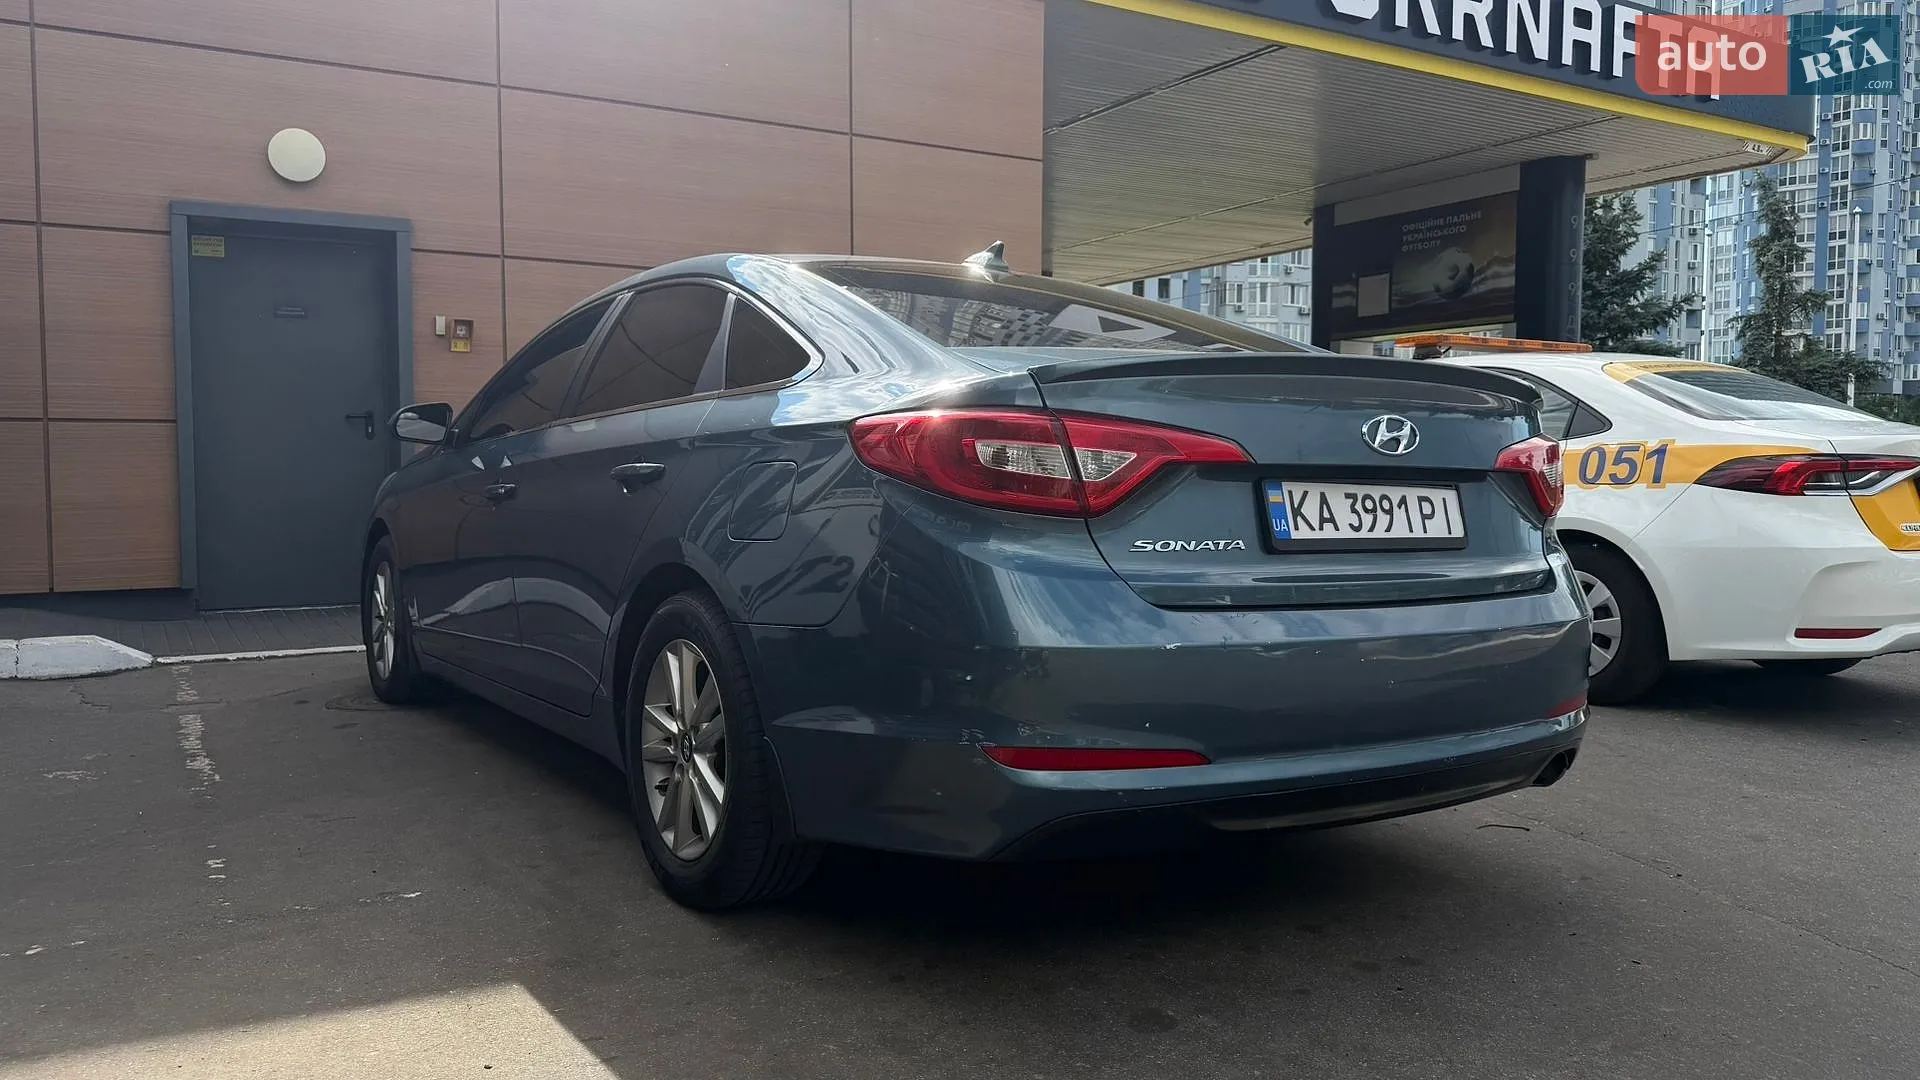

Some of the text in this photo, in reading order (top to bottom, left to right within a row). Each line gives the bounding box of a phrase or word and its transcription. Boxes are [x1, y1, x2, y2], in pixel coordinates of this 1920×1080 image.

[1330, 0, 1720, 100] RNAFTA
[1402, 211, 1482, 232] ОФІЦІЙНЕ ПАЛЬНЕ
[1402, 225, 1467, 242] УКРАЇНСЬКОГО
[1402, 240, 1441, 252] ФУТБОЛУ
[1578, 444, 1669, 485] 051
[1287, 490, 1453, 535] KA 3991 PI
[1272, 518, 1289, 532] UA
[1128, 539, 1246, 552] SONATA
